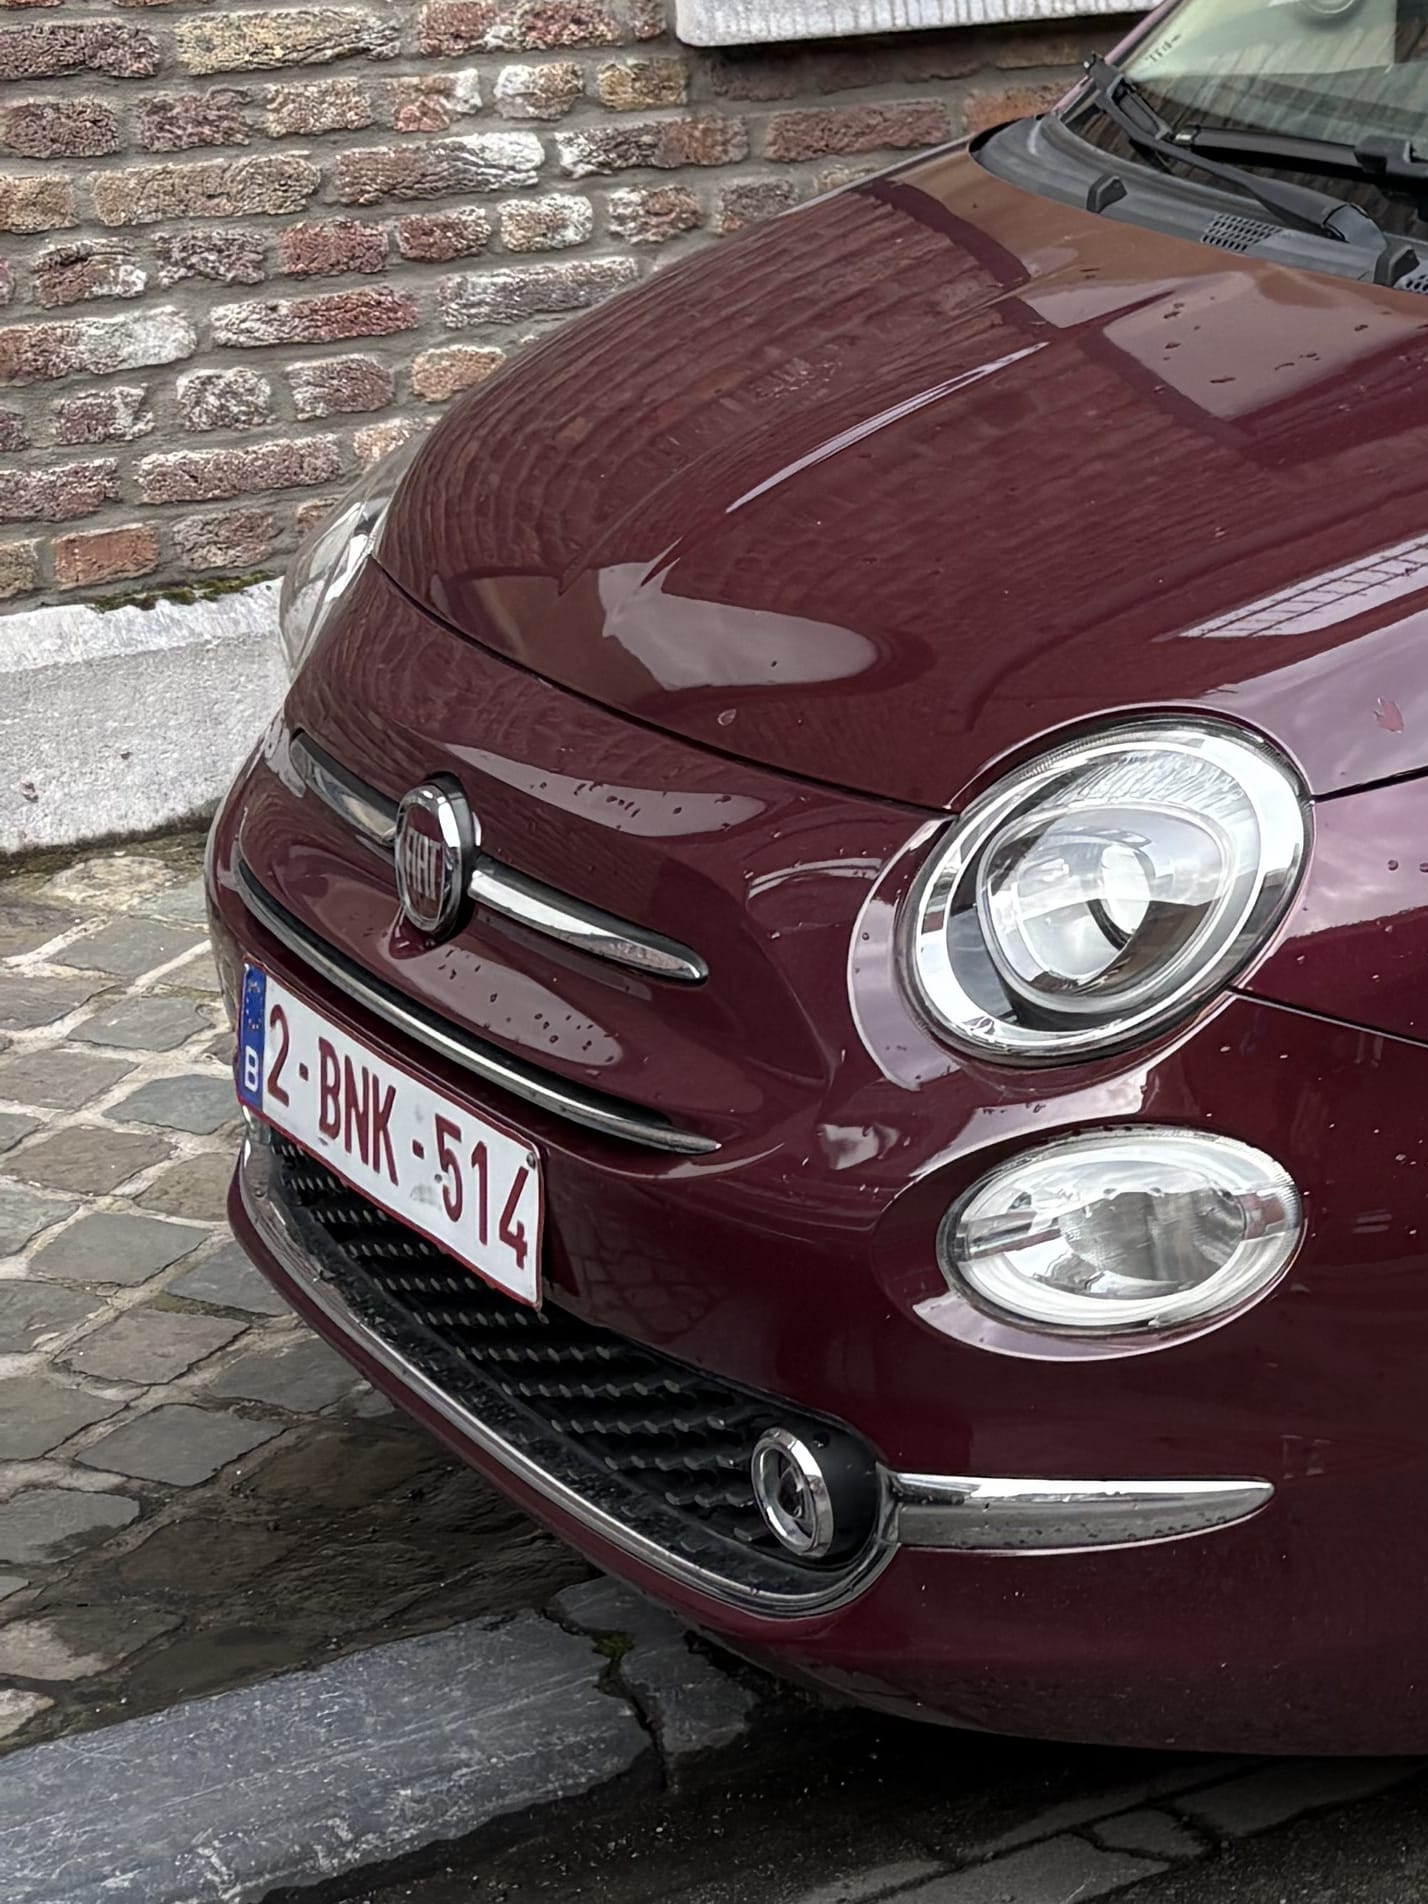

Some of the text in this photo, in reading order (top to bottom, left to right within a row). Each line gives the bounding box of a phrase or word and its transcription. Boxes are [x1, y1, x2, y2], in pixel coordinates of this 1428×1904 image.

[406, 826, 442, 901] FIAT
[244, 1044, 259, 1093] B
[266, 1003, 530, 1270] 2-BNK-514
